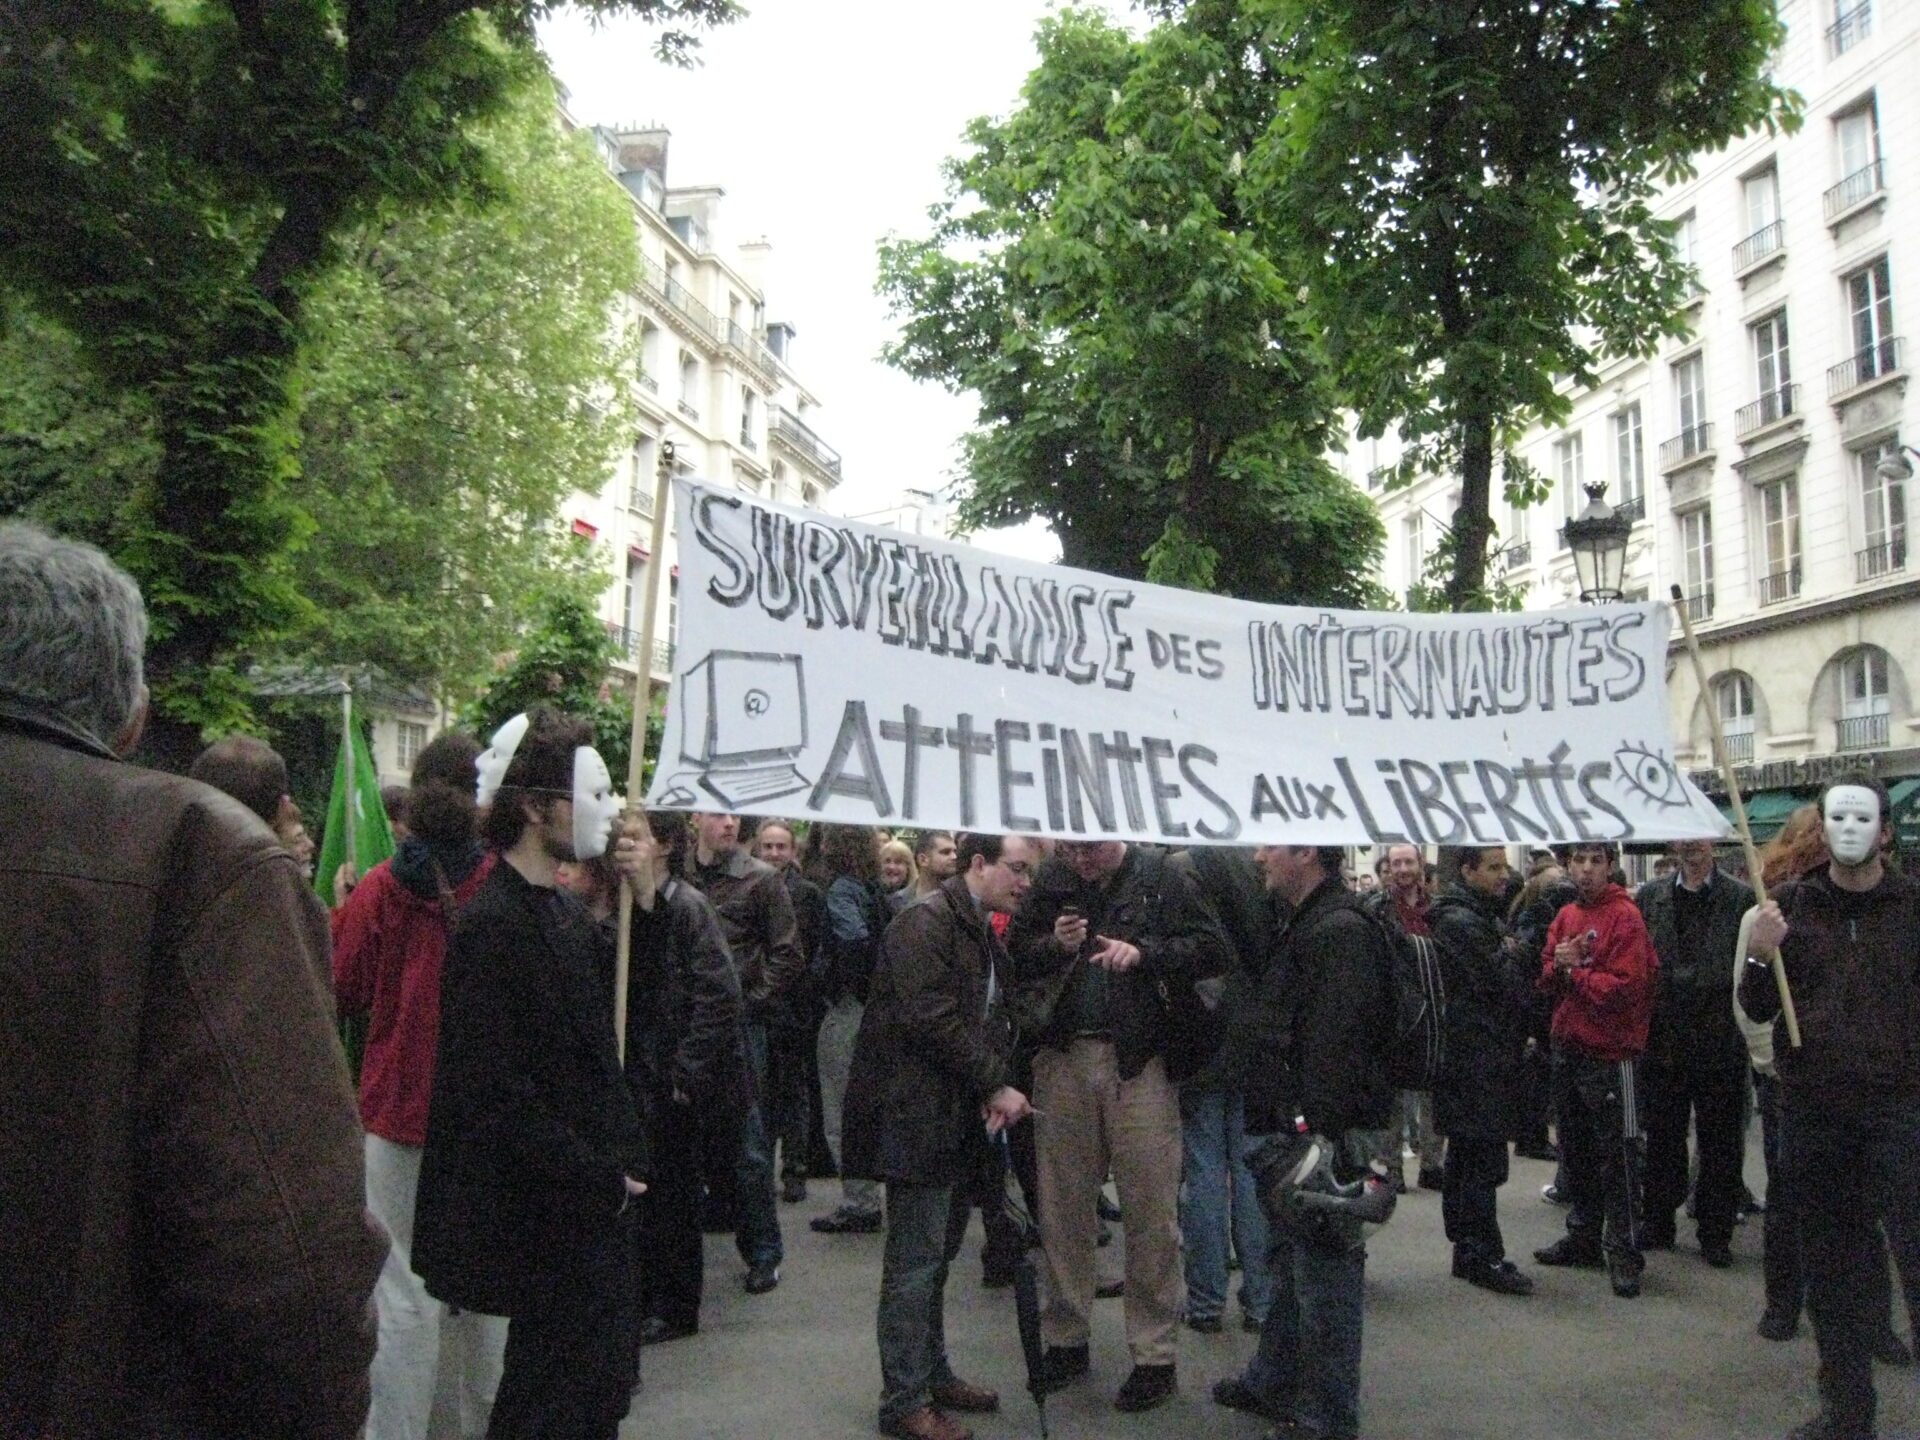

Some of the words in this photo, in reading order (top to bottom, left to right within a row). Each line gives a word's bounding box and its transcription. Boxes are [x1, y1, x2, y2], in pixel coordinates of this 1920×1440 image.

[690, 486, 1135, 692] SURVEILLANCE
[1146, 628, 1226, 680] DES
[1249, 612, 1646, 719] INTERNAUTES
